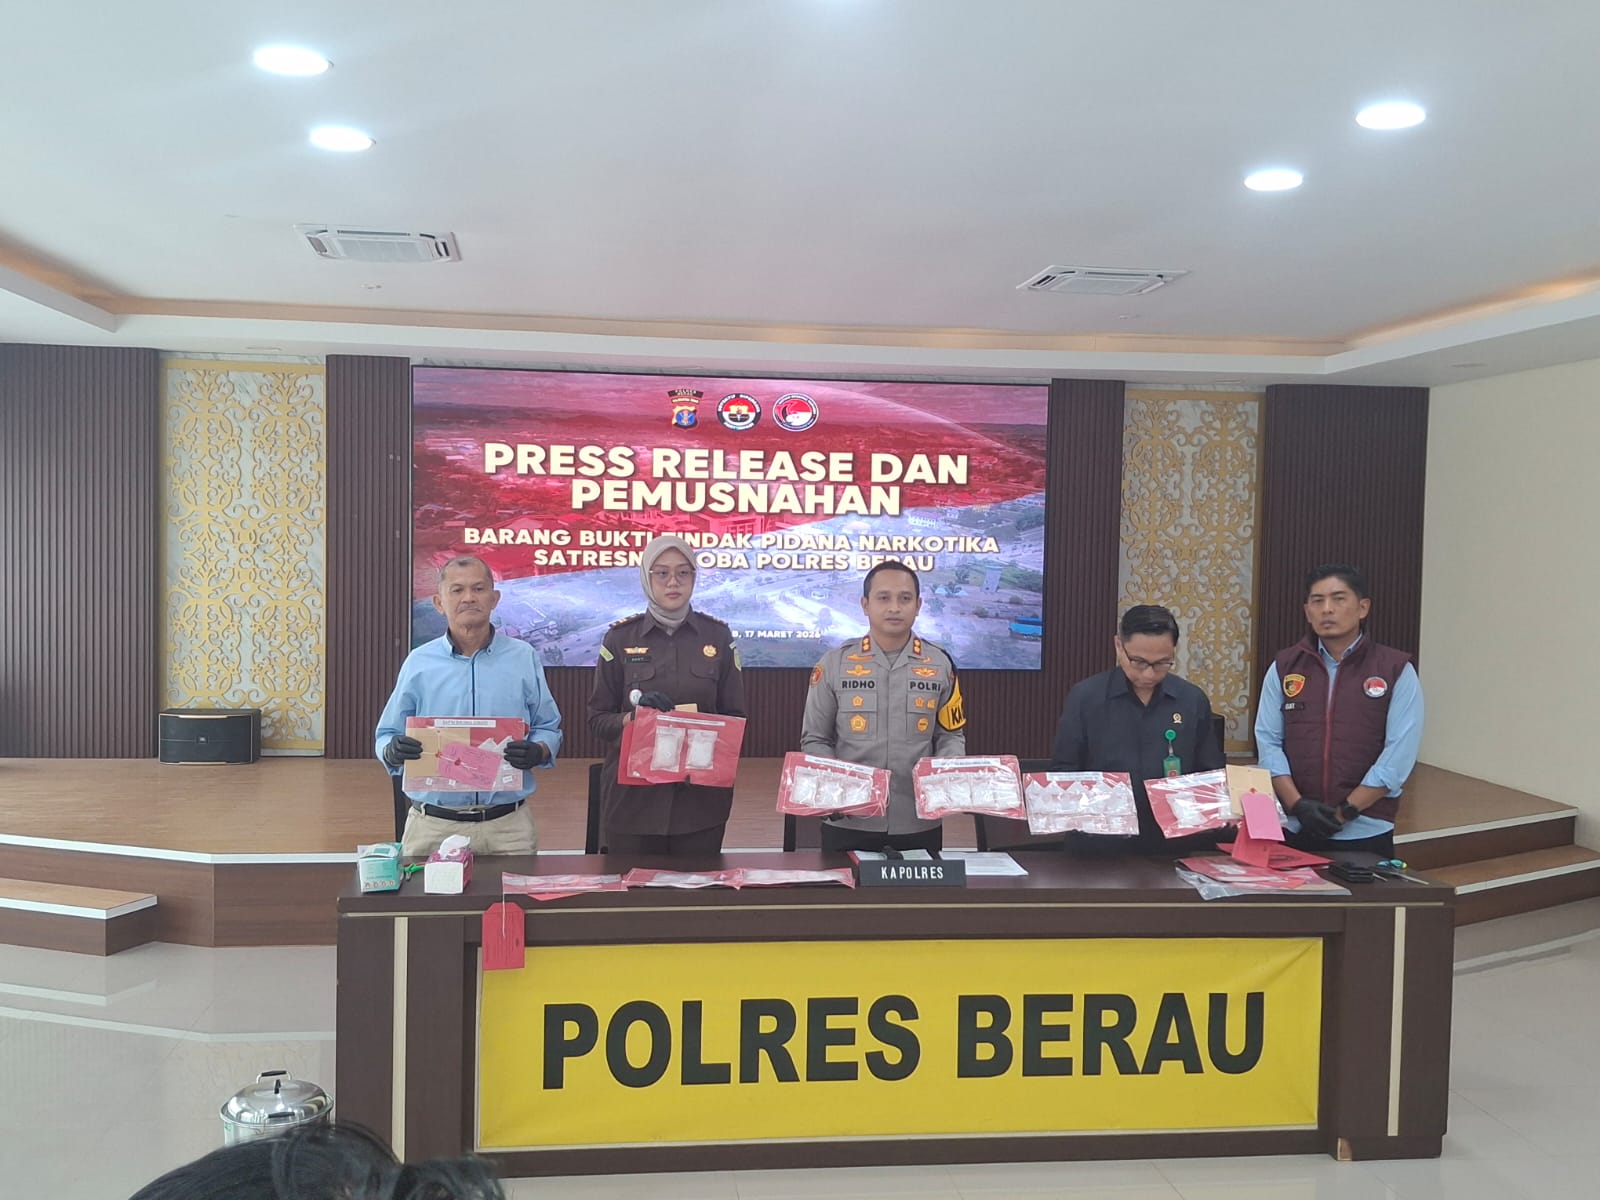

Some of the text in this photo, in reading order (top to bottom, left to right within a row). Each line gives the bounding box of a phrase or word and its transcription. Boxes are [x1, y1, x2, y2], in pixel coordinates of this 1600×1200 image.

[484, 442, 968, 484] PRESS RELEASE DAN
[571, 479, 900, 516] PEMUSNAHAN
[464, 527, 572, 546] BARANG
[761, 533, 853, 551] PIDANA
[859, 534, 999, 553] NARKOTIKA
[756, 552, 849, 570] POLRES
[745, 630, 754, 638] 17
[757, 630, 794, 638] MARET
[796, 630, 821, 639] 2026
[842, 680, 875, 689] RIDHO
[910, 681, 941, 691] POLRI
[881, 866, 944, 880] KAPOLRES
[542, 991, 1265, 1090] POLRES BERAU
